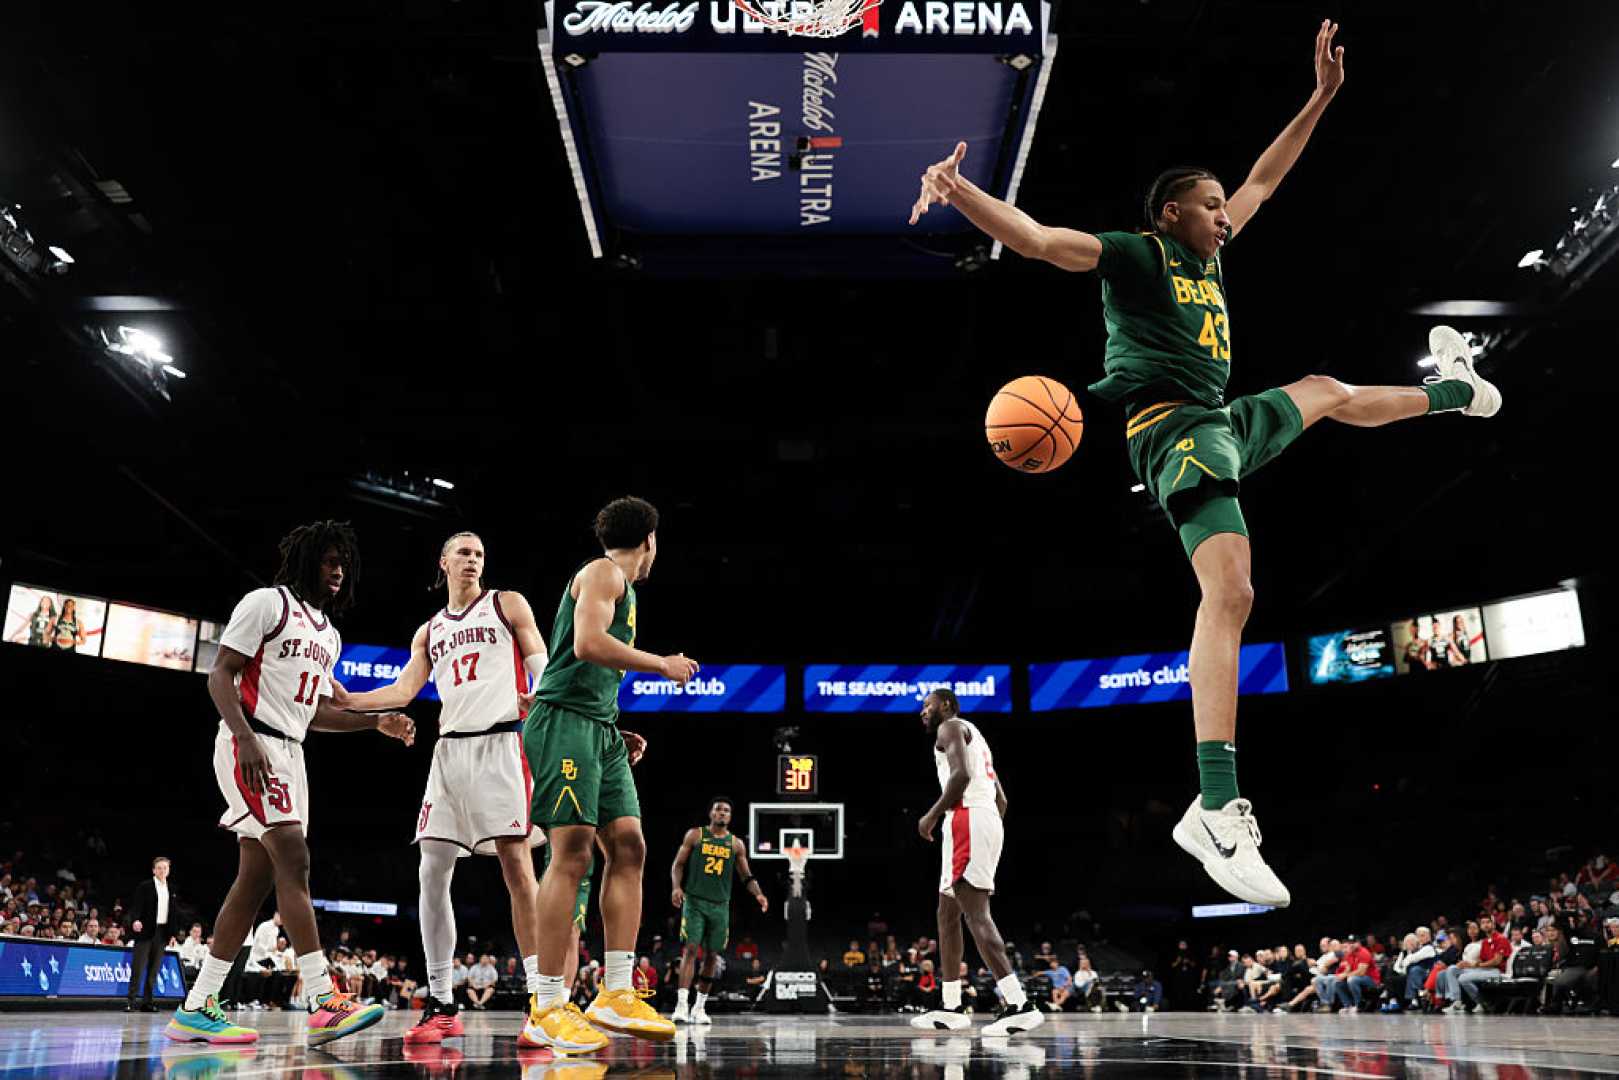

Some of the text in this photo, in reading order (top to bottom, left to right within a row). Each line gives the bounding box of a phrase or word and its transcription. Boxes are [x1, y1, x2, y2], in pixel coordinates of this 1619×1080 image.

[563, 0, 1033, 35] Michelob ULTR ARENA
[748, 101, 781, 181] ARENA
[800, 52, 838, 226] Michelob ULTRA
[1172, 276, 1226, 310] BEA
[1198, 311, 1231, 359] 43
[279, 639, 301, 658] ST.
[431, 627, 497, 663] ST. JOHN'S
[341, 660, 372, 677] THE
[452, 652, 480, 687] 17
[817, 681, 846, 696] THE
[848, 681, 907, 696] SEASON
[954, 675, 995, 696] and
[1099, 669, 1152, 689] sam's
[294, 671, 320, 705] 11
[685, 677, 725, 695] club
[785, 769, 811, 790] 30
[704, 856, 724, 876] 24
